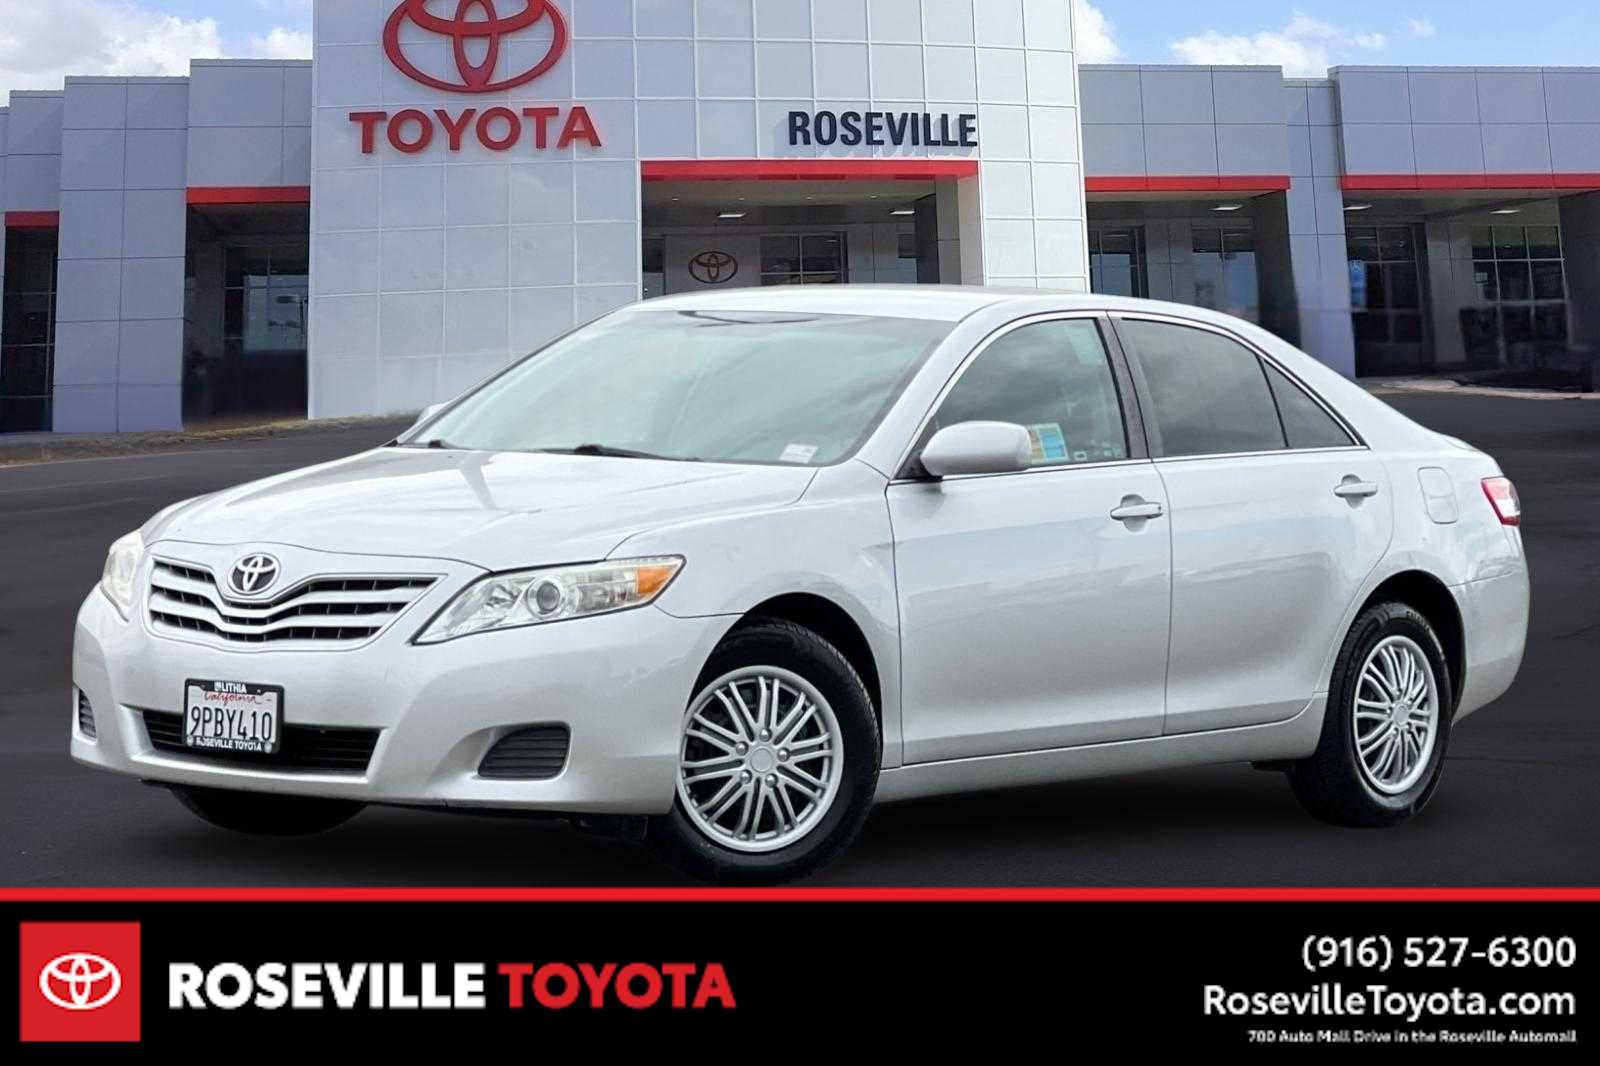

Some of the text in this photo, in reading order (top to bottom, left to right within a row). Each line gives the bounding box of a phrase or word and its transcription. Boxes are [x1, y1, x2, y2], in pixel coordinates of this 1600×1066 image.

[349, 106, 602, 154] TOYOTA
[788, 111, 978, 147] ROSEVILLE
[221, 682, 247, 693] LITHIA
[191, 706, 272, 741] 9PBY410
[195, 738, 262, 752] ROSEVILLE TOYOTA
